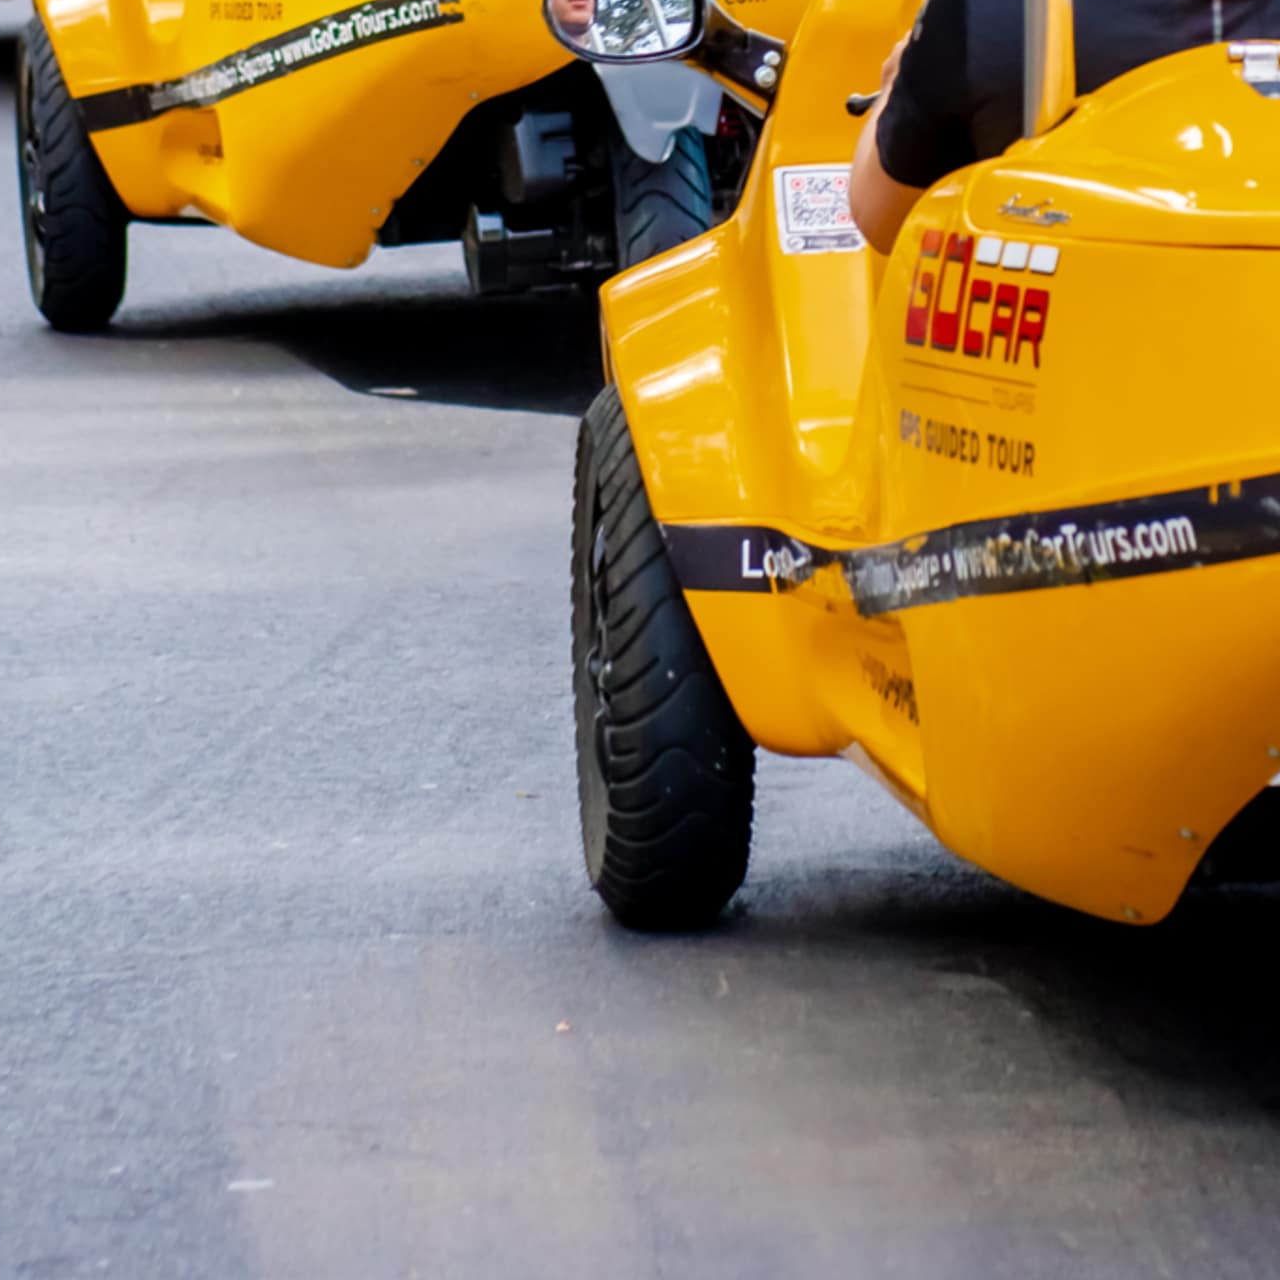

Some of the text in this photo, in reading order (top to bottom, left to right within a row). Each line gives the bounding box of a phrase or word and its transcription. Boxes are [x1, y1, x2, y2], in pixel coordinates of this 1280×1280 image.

[899, 407, 1036, 477] GPS GUIDED TOUR
